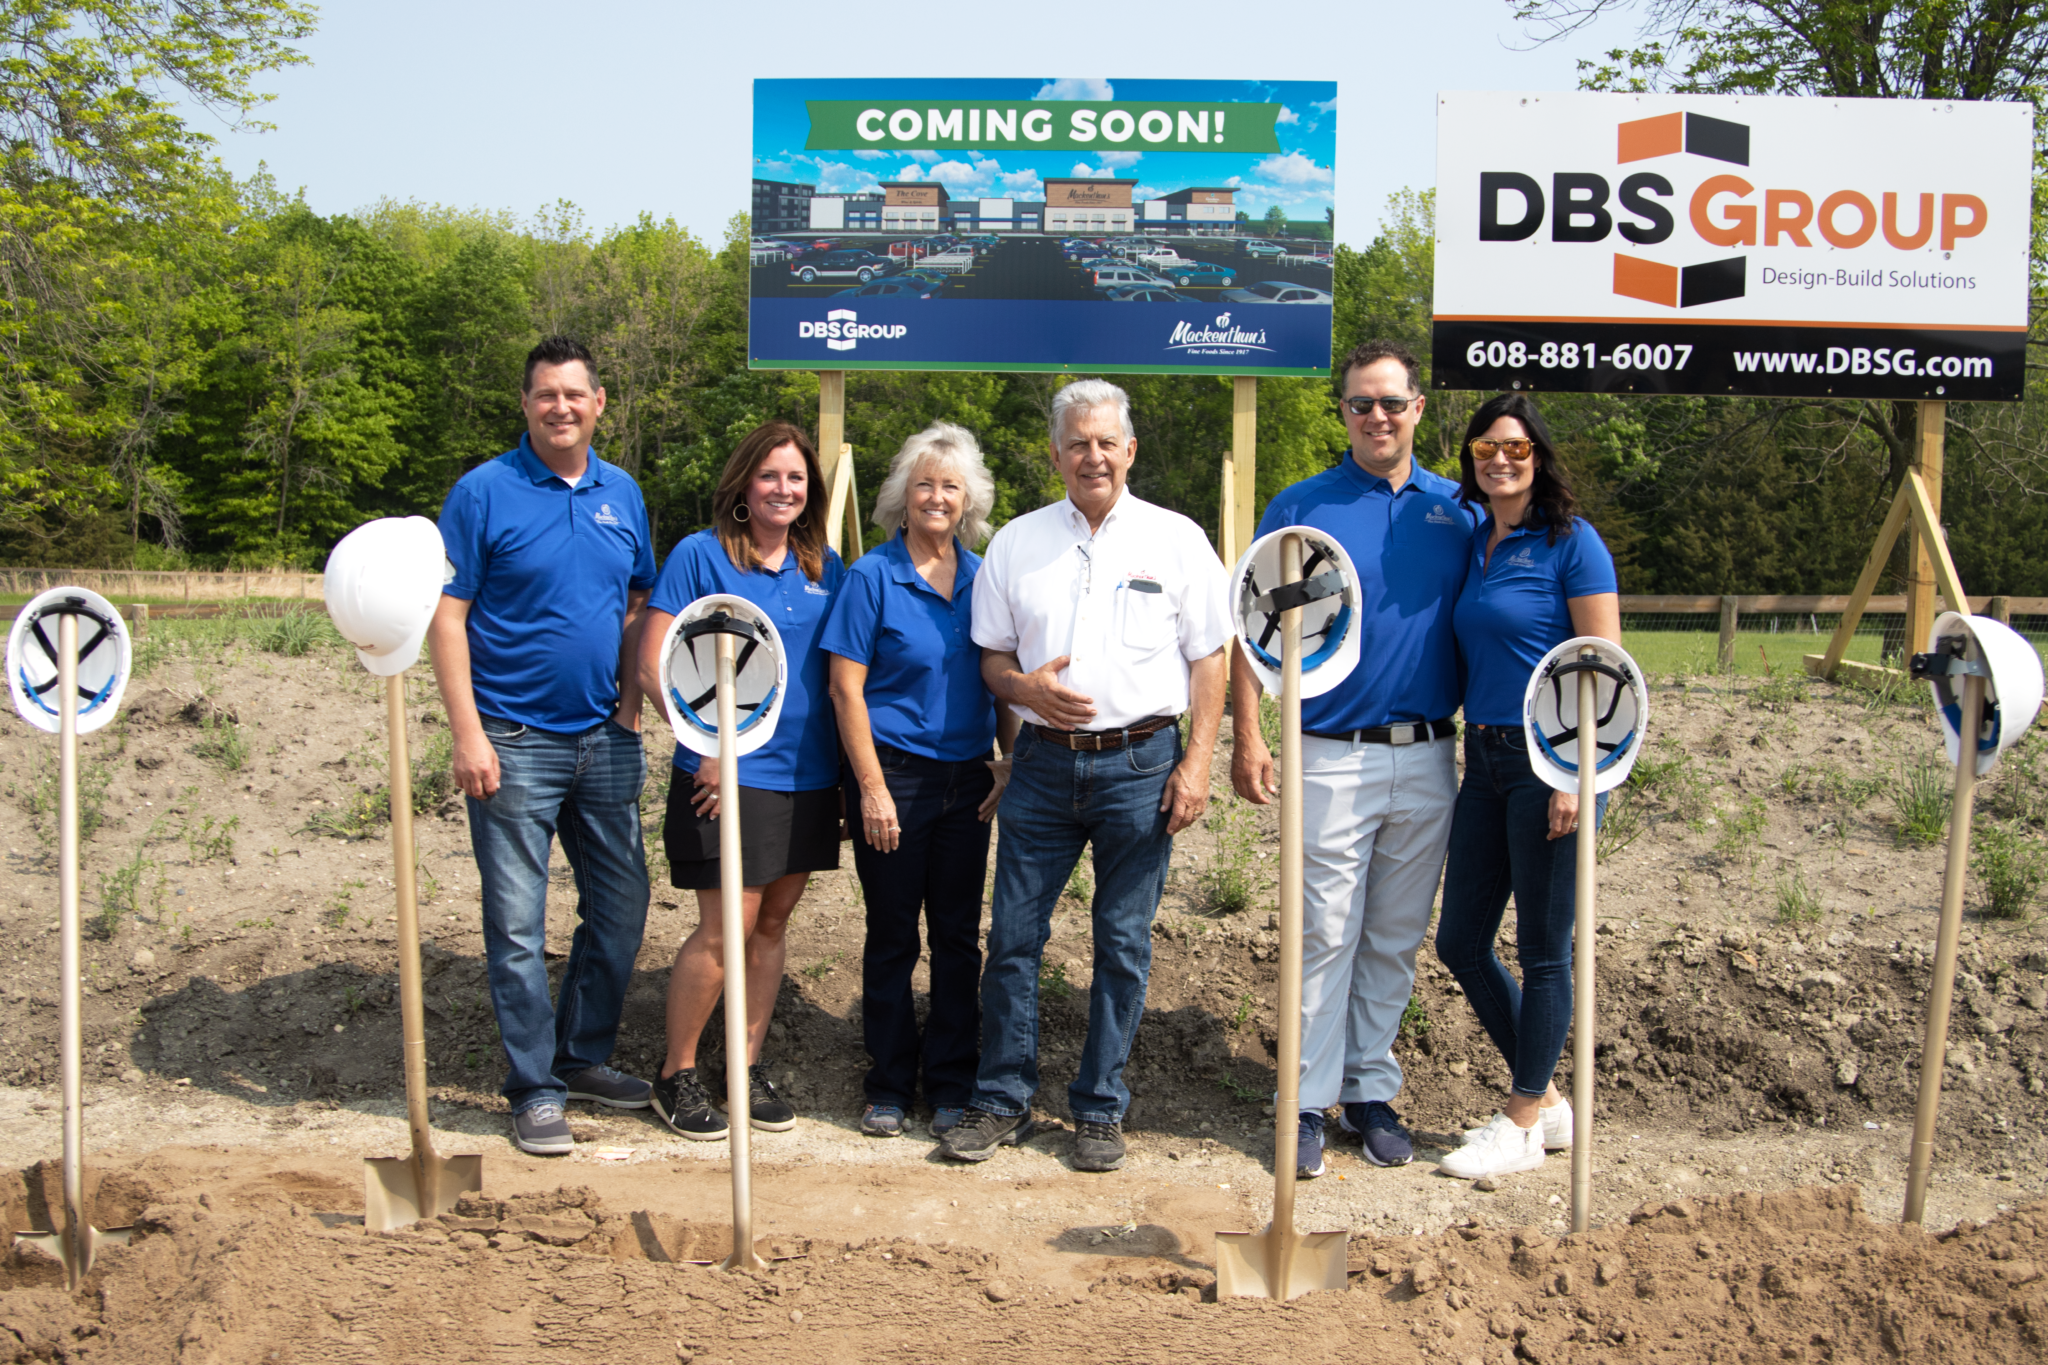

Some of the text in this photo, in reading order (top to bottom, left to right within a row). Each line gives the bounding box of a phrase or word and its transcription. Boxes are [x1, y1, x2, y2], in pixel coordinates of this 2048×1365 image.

[856, 107, 1226, 144] COMING SOON!
[1762, 267, 1977, 290] Design-Build Solutions
[1168, 319, 1267, 345] Mackenthun's
[1466, 340, 1994, 378] 608-881-6007 www.DBSG.com
